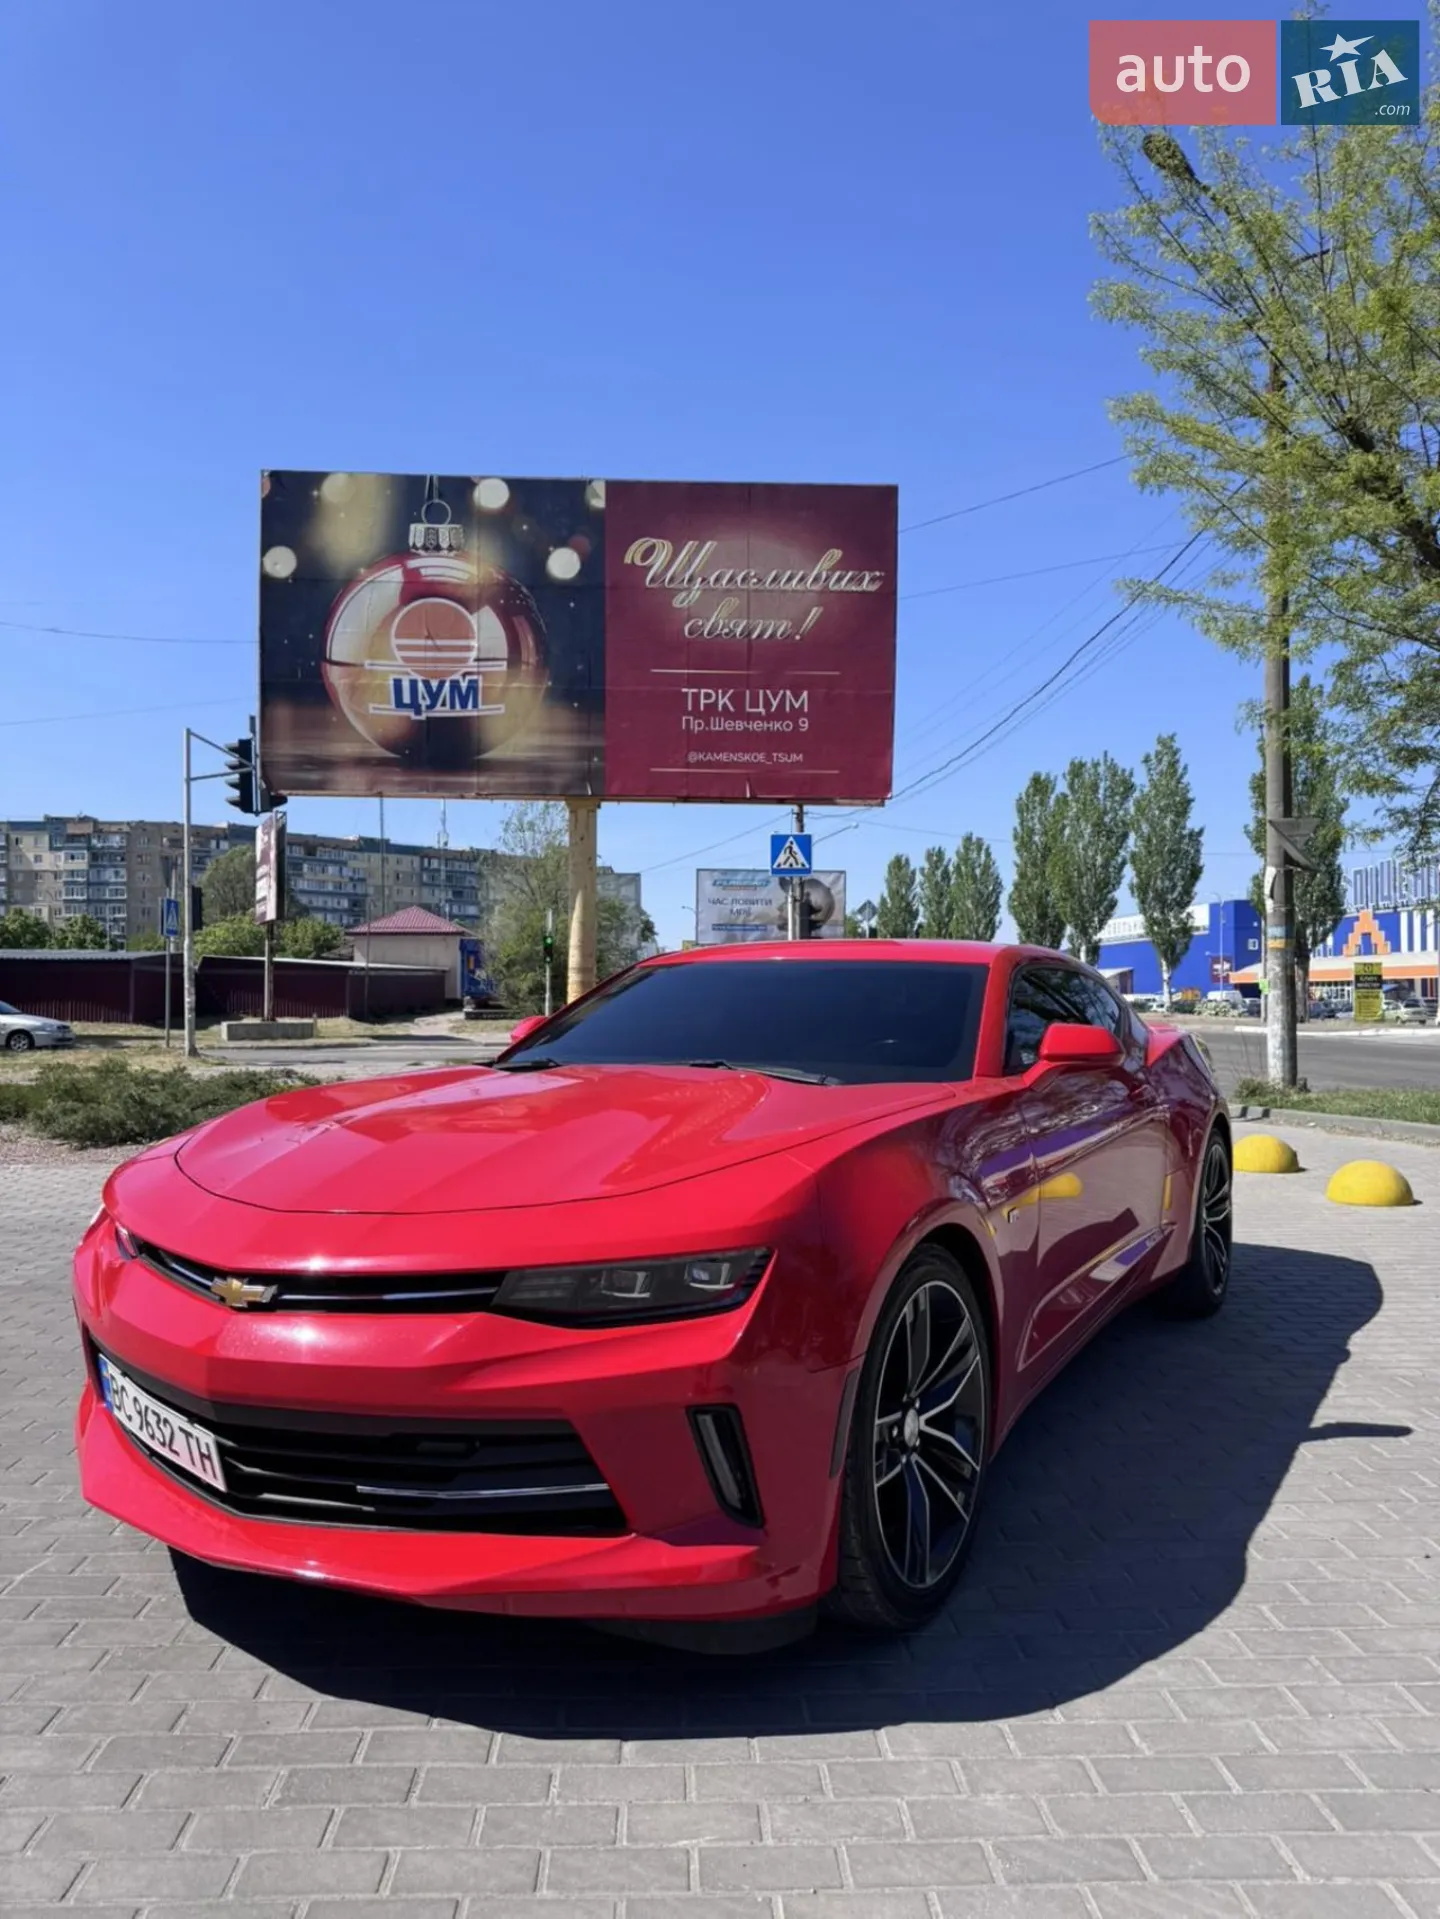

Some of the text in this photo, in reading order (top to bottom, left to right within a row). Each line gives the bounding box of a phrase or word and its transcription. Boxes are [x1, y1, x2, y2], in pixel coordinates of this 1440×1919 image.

[624, 537, 885, 608] Щасливих
[684, 597, 823, 640] свят!
[392, 677, 480, 717] ЦУМ
[681, 688, 809, 716] ТРК ЦУМ
[682, 716, 809, 734] Пр.Шевченко 9
[687, 752, 803, 764] @KAMENSKOE_TSUM
[132, 1395, 180, 1457] 9632
[178, 1426, 219, 1481] TH
